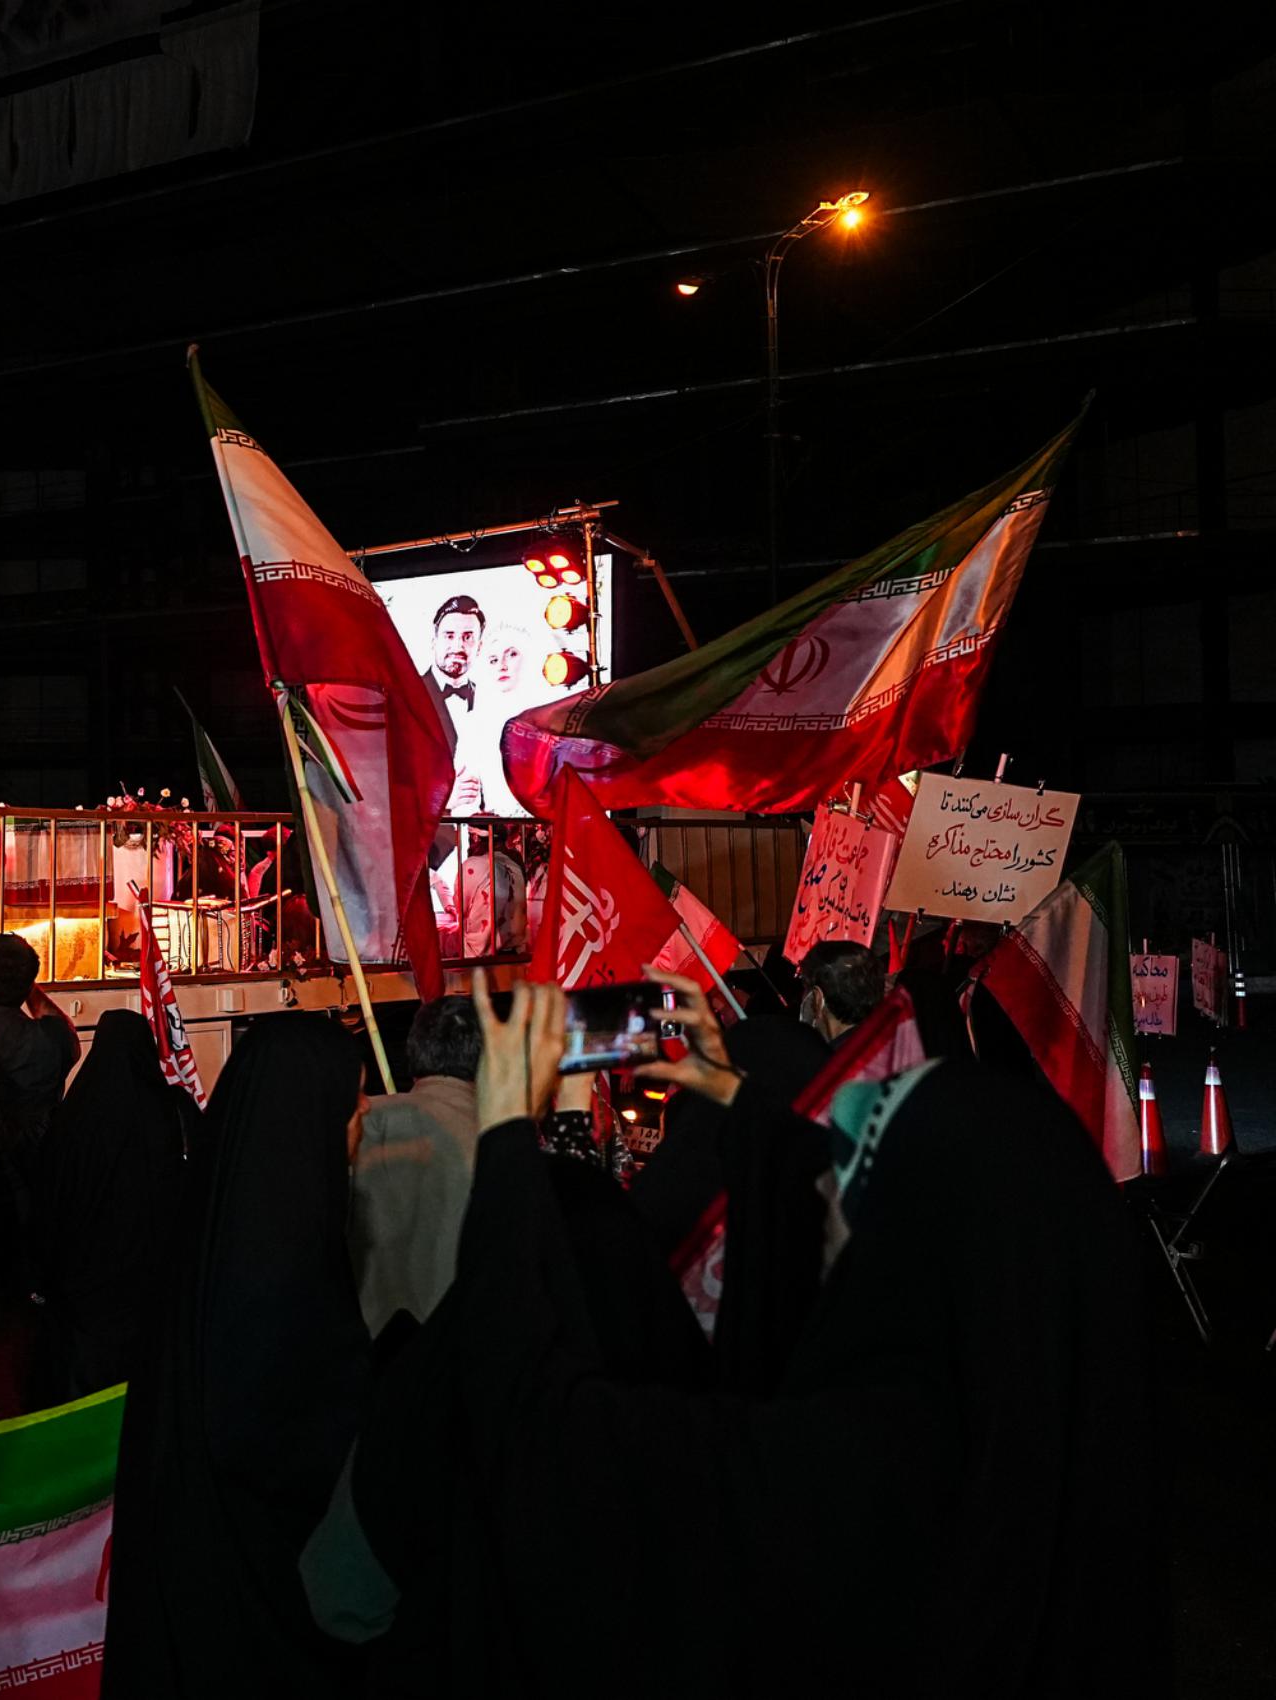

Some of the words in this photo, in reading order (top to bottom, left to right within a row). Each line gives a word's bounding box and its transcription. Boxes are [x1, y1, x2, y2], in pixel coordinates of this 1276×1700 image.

[940, 791, 953, 811] تا
[970, 839, 1012, 867] محتاج
[1003, 843, 1018, 870] را
[1015, 849, 1057, 873] کشور
[982, 882, 1016, 902] نشان
